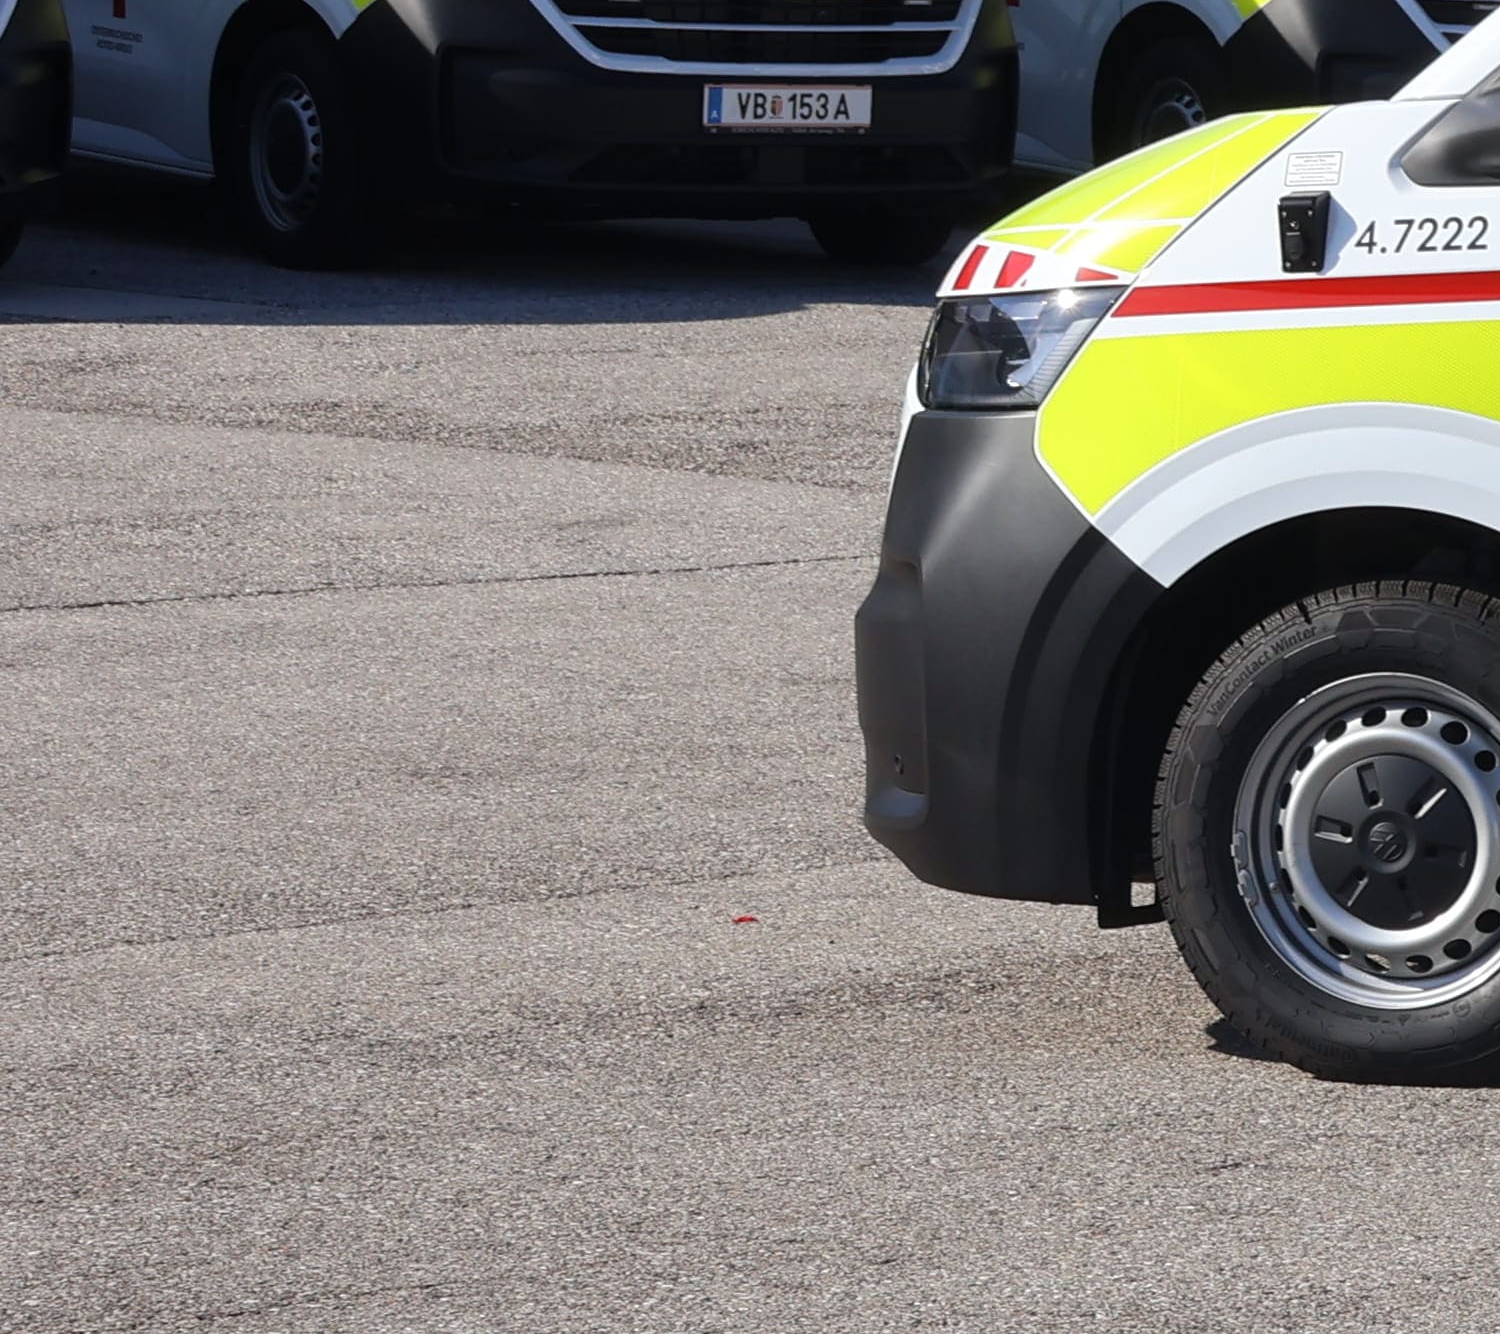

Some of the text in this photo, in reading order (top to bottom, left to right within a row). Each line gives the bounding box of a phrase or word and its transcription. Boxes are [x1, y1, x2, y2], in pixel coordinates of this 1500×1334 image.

[737, 92, 850, 121] VB 153 A
[1354, 215, 1489, 255] 4.7222
[1206, 626, 1317, 715] VanContact Winter
